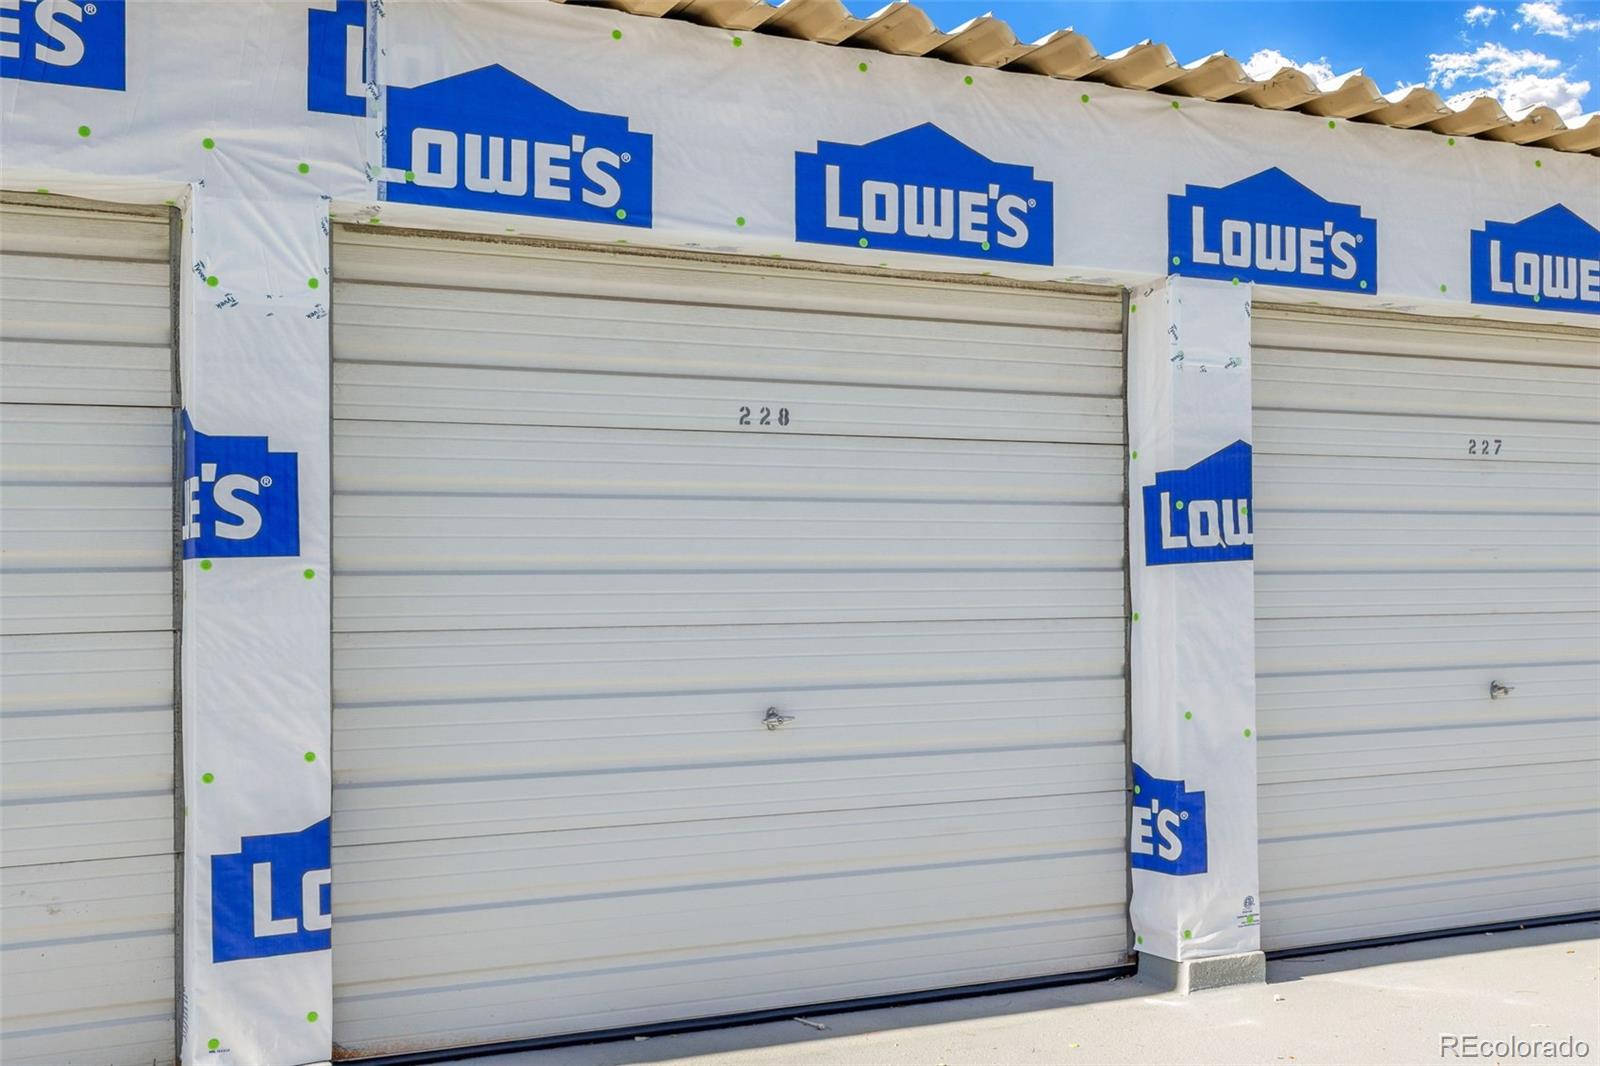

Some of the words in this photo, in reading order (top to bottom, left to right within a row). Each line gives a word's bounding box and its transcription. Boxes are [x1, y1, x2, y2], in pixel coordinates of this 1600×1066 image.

[826, 164, 1029, 248] LOWE'S
[1192, 206, 1357, 280] LOWE'S
[1490, 240, 1600, 304] LOWE
[739, 406, 790, 426] 228
[1468, 439, 1502, 455] 227
